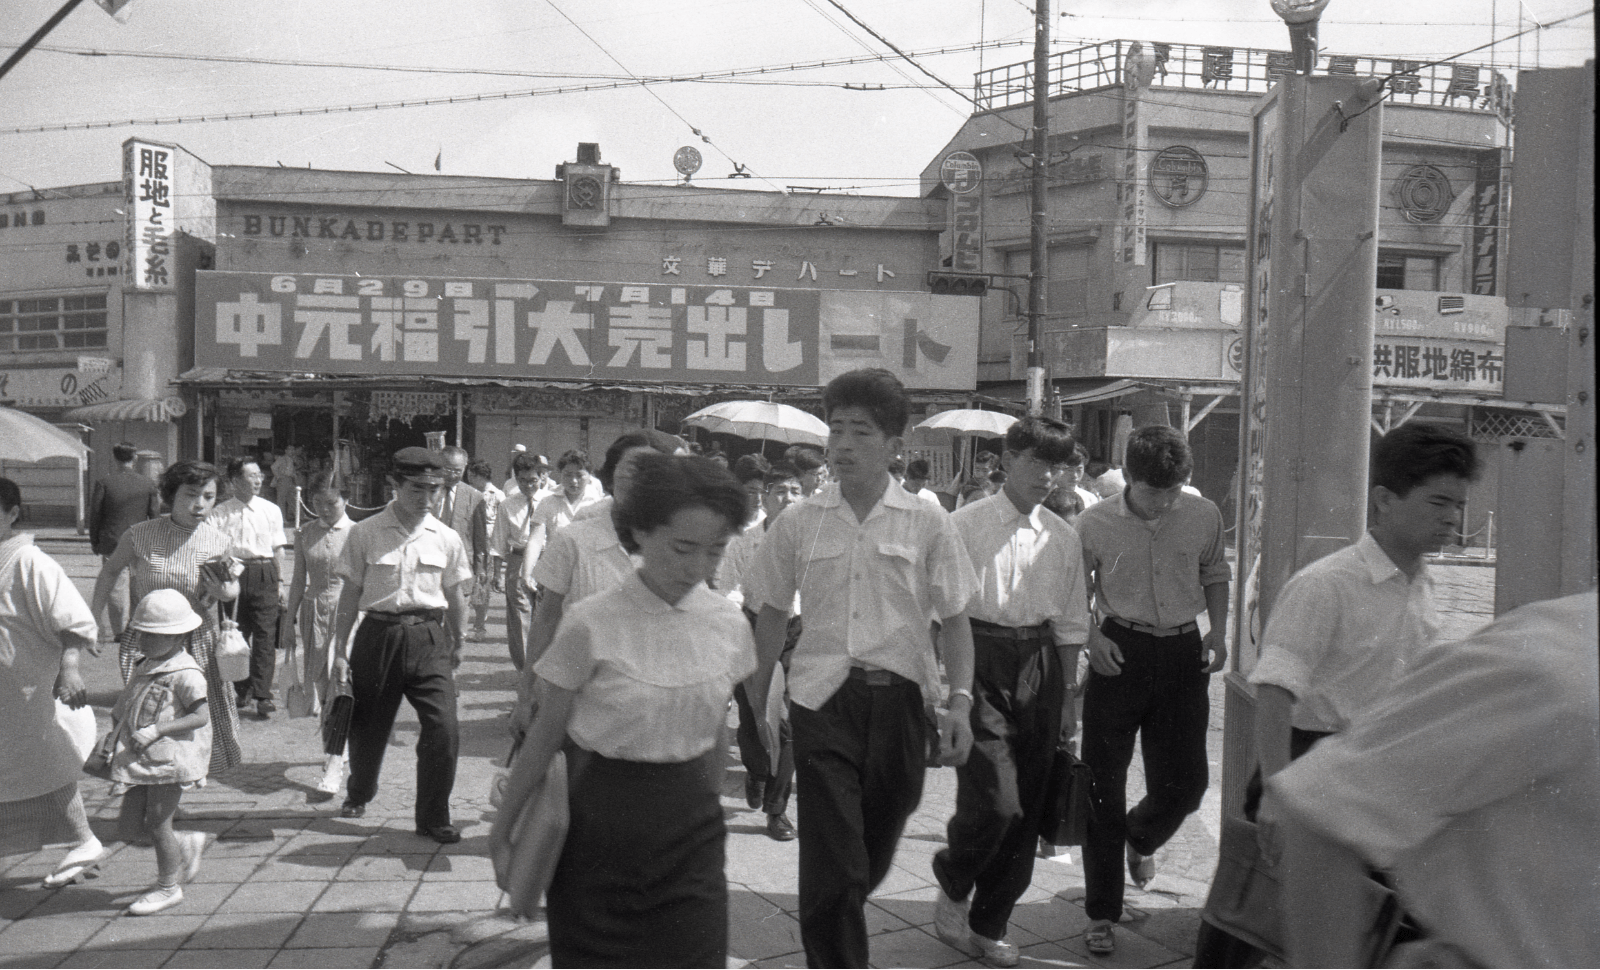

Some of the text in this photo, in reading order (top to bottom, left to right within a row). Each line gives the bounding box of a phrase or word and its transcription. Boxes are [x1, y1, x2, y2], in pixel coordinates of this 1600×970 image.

[139, 148, 170, 285] 服地と毛糸
[662, 255, 896, 283] 文華デパート
[215, 292, 804, 373] 中元福引大売出し
